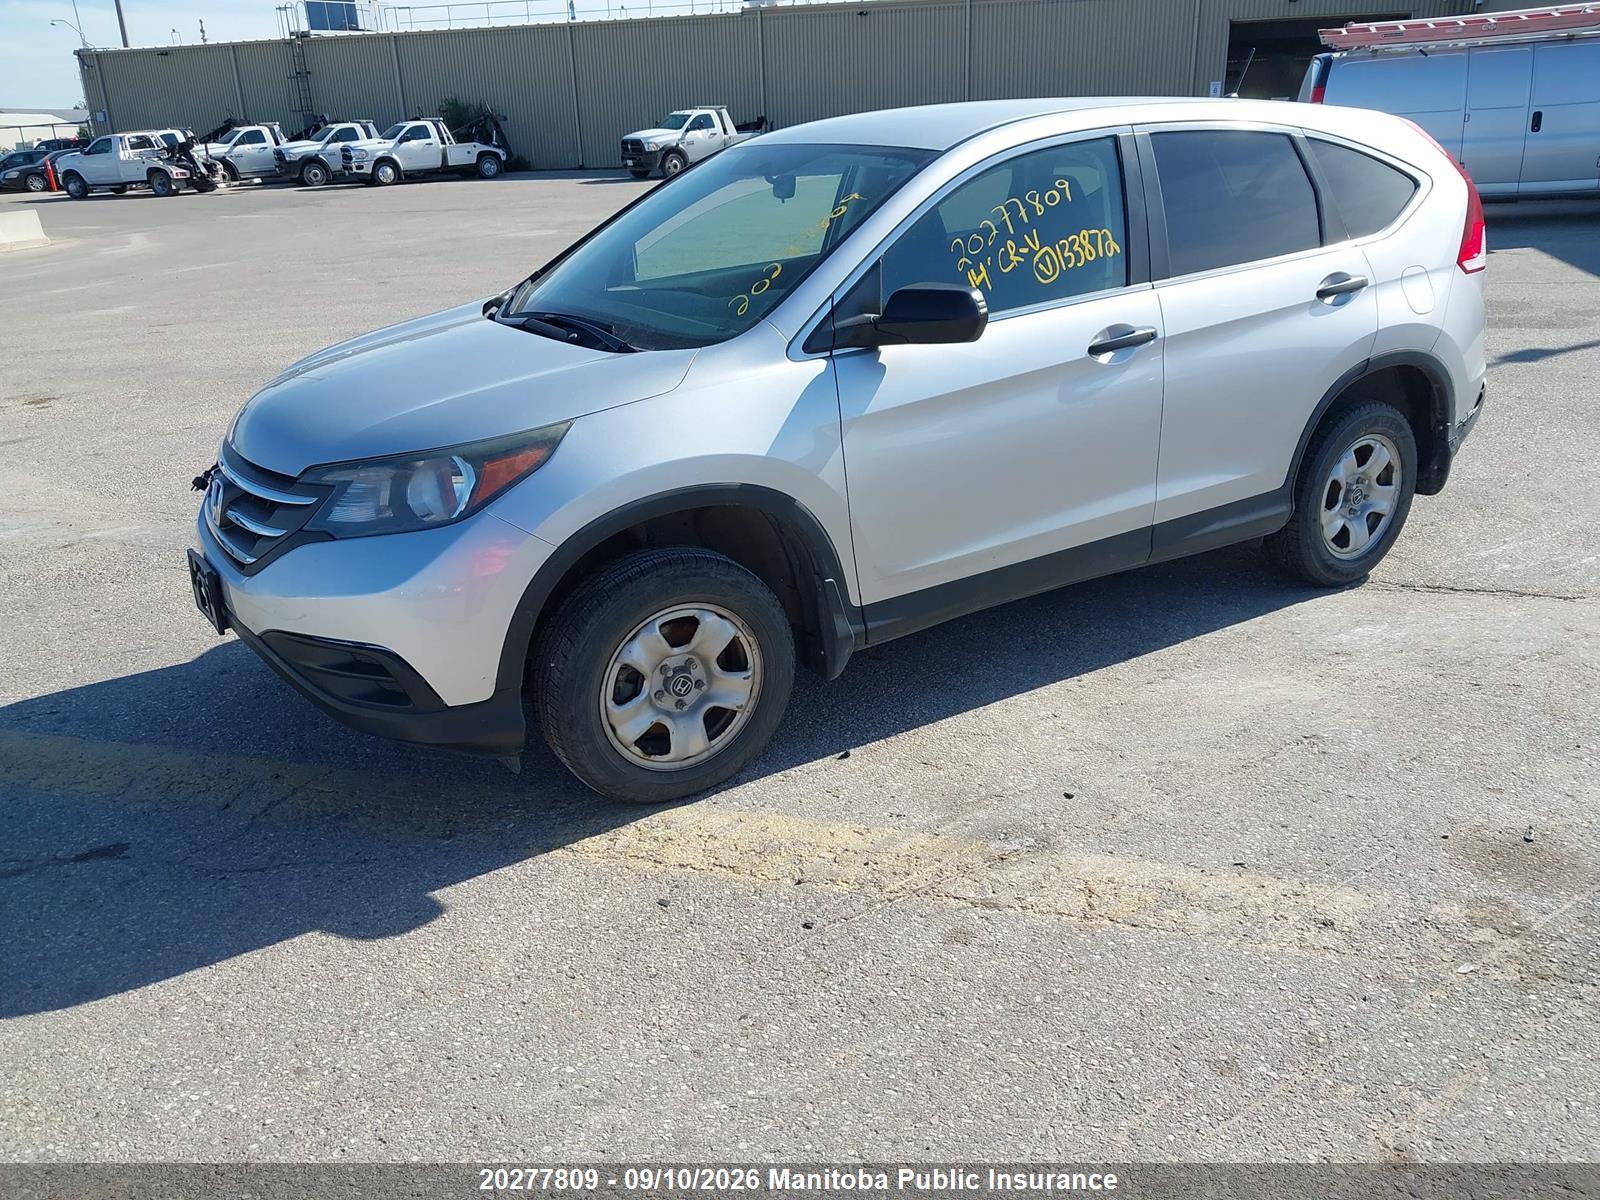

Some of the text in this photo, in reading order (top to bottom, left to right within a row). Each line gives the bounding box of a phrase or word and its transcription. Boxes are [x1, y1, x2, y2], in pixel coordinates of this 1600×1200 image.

[951, 179, 1071, 272] 20277809
[998, 229, 1040, 273] CR-V
[1055, 228, 1121, 270] 133872
